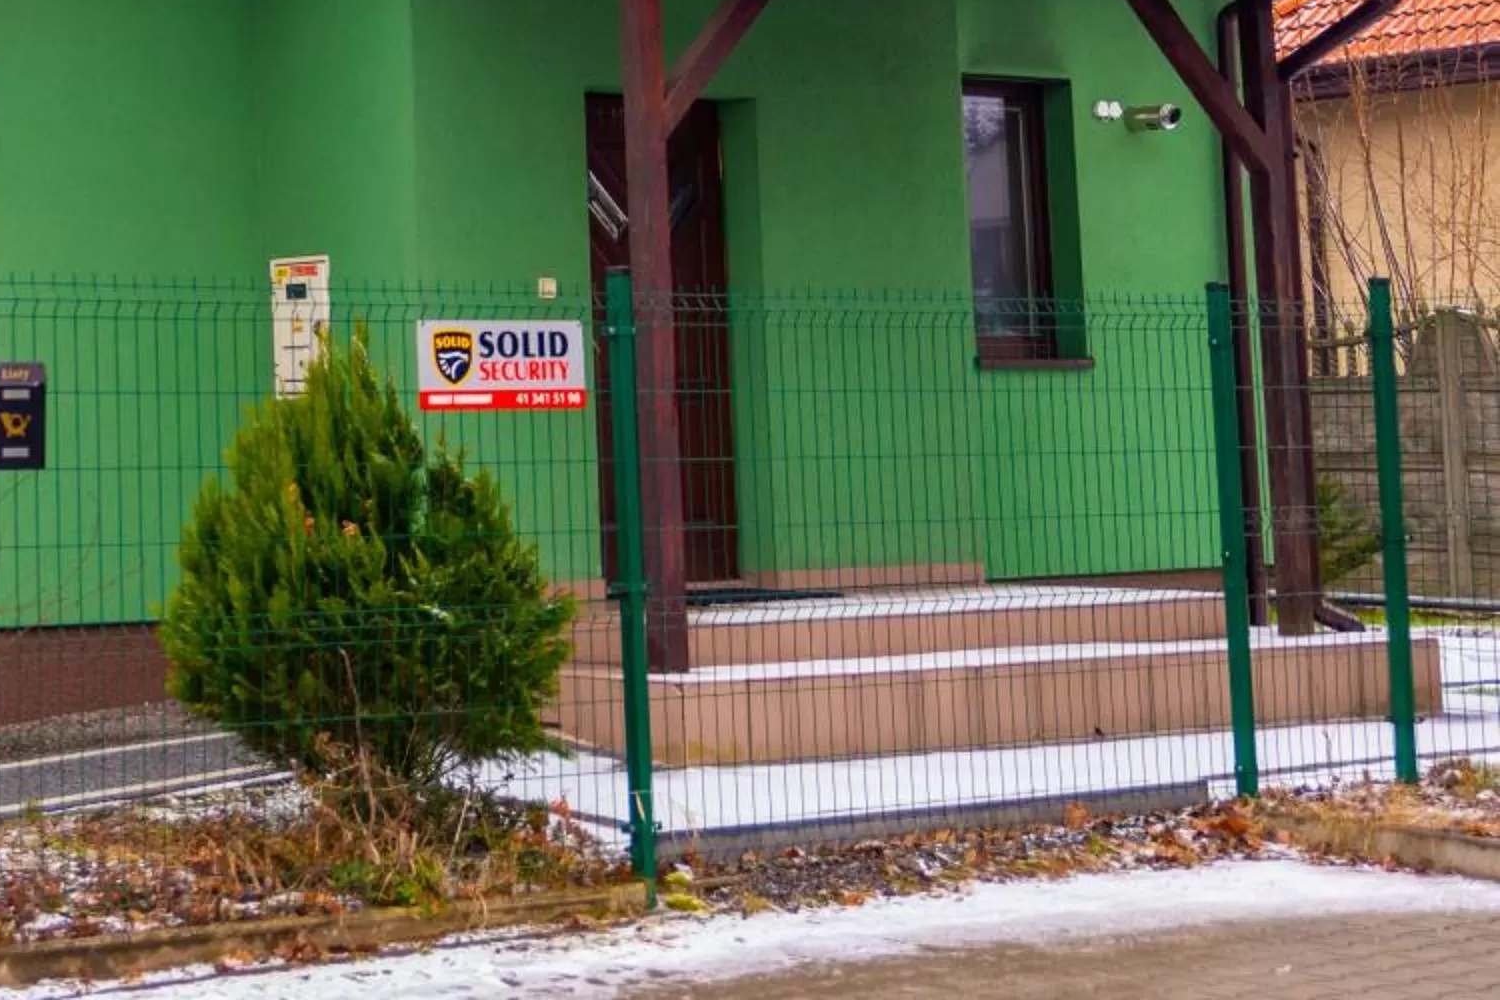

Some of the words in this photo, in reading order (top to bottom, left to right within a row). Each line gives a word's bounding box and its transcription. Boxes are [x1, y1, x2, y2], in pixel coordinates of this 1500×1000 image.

[435, 336, 470, 348] SOLID
[479, 331, 569, 358] SOLID
[479, 360, 569, 381] SECURITY
